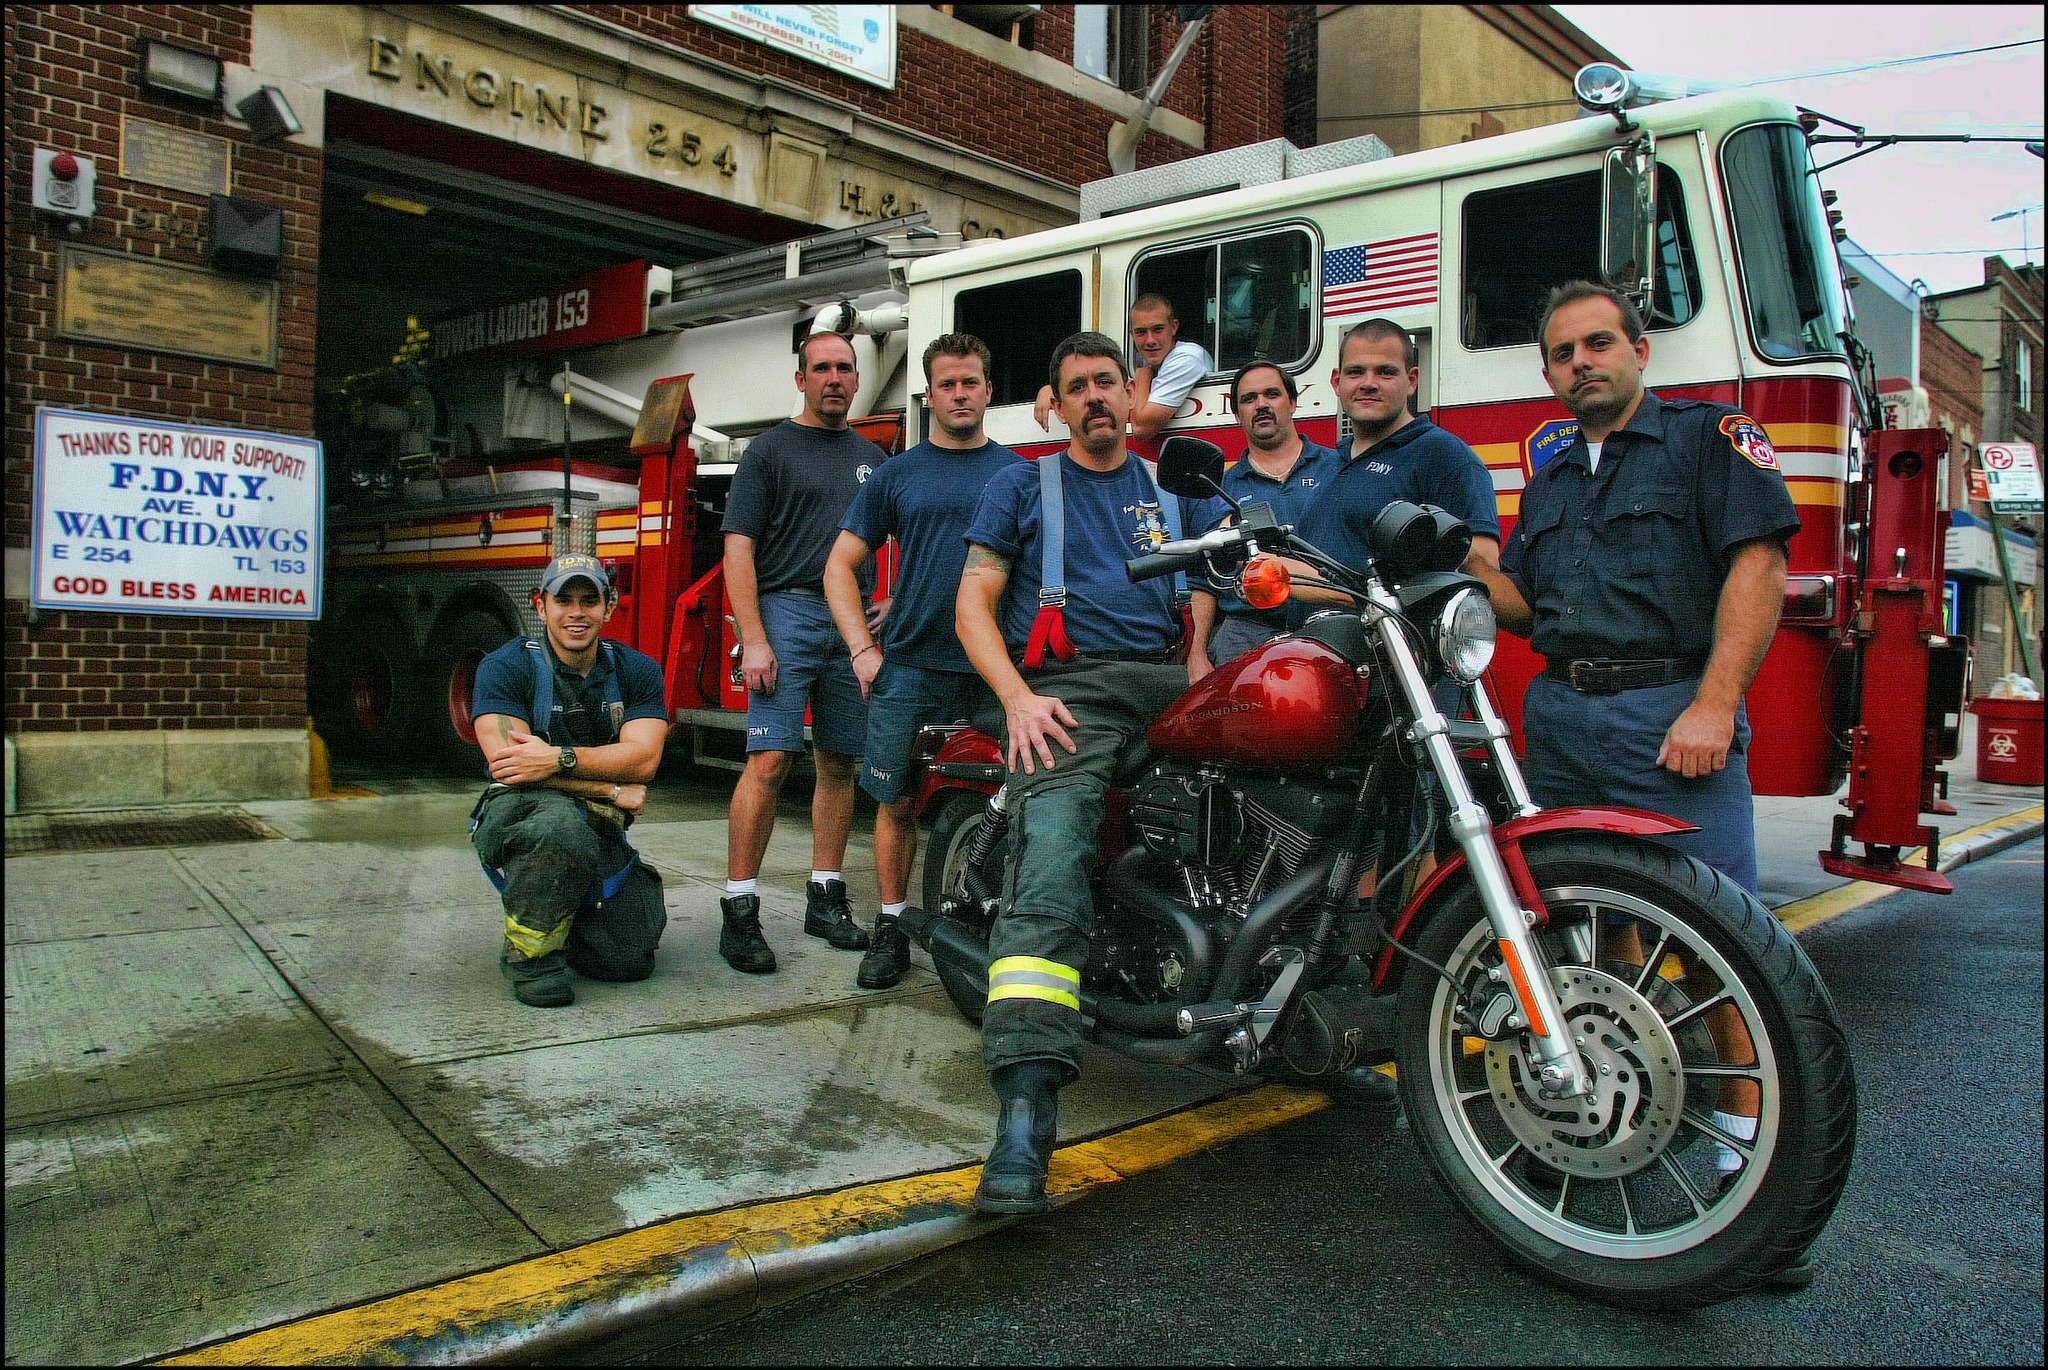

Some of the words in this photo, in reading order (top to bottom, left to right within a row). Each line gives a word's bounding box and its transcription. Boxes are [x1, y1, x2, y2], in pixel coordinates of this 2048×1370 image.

[730, 11, 804, 45] SEPTEMBER
[827, 48, 854, 64] 2001
[775, 14, 816, 37] NEVER
[819, 31, 864, 55] FORGET
[368, 37, 608, 142] ENGINE
[647, 122, 738, 177] 254
[487, 296, 549, 345] LADDER
[555, 289, 590, 331] 153
[1536, 432, 1558, 450] FIRE
[1558, 425, 1579, 437] DEP
[57, 432, 132, 457] THANKS
[138, 433, 173, 457] FOR
[181, 436, 226, 462] YOUR
[232, 443, 306, 481] SUPPORT!
[1365, 461, 1394, 476] FDNY
[109, 462, 275, 502] F.D.N.Y.
[142, 498, 201, 516] AVE.
[216, 503, 235, 519] U
[54, 510, 308, 554] WATCHDAWGS
[52, 544, 69, 560] E
[83, 546, 131, 564] 254
[233, 556, 259, 571] TL
[271, 559, 306, 575] 153
[54, 576, 108, 595] GOD
[122, 580, 196, 600] BLESS
[209, 585, 306, 606] AMERICA
[748, 726, 769, 736] FDNY
